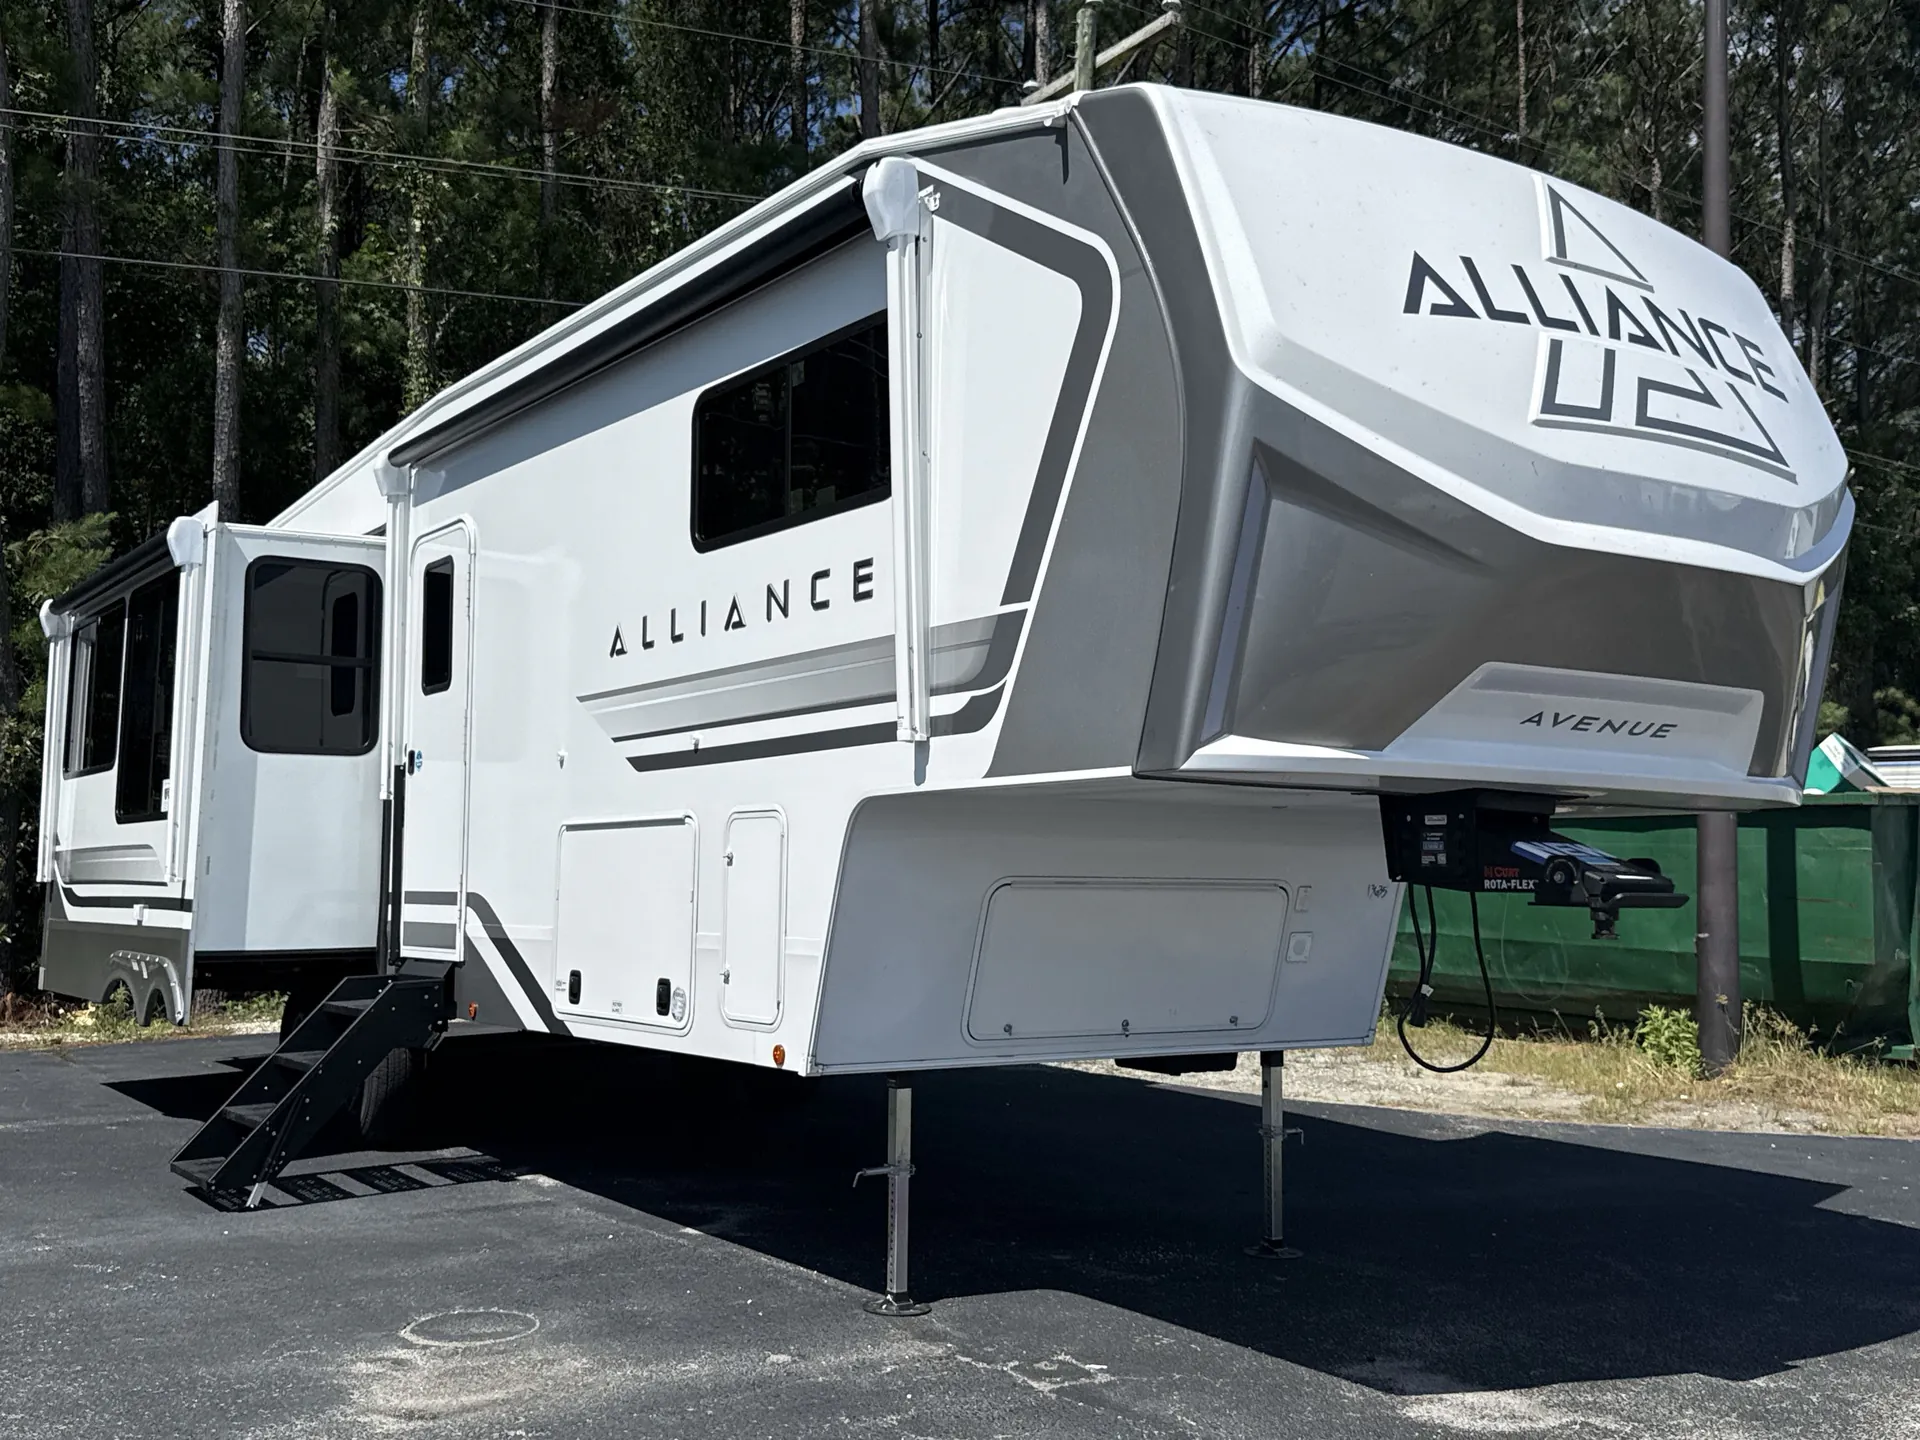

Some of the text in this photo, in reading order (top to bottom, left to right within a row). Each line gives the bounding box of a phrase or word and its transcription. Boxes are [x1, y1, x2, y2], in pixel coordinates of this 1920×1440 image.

[1403, 250, 1789, 404] ALLIANCE
[609, 556, 874, 658] ALLIANCE
[1519, 710, 1678, 739] AVENUE
